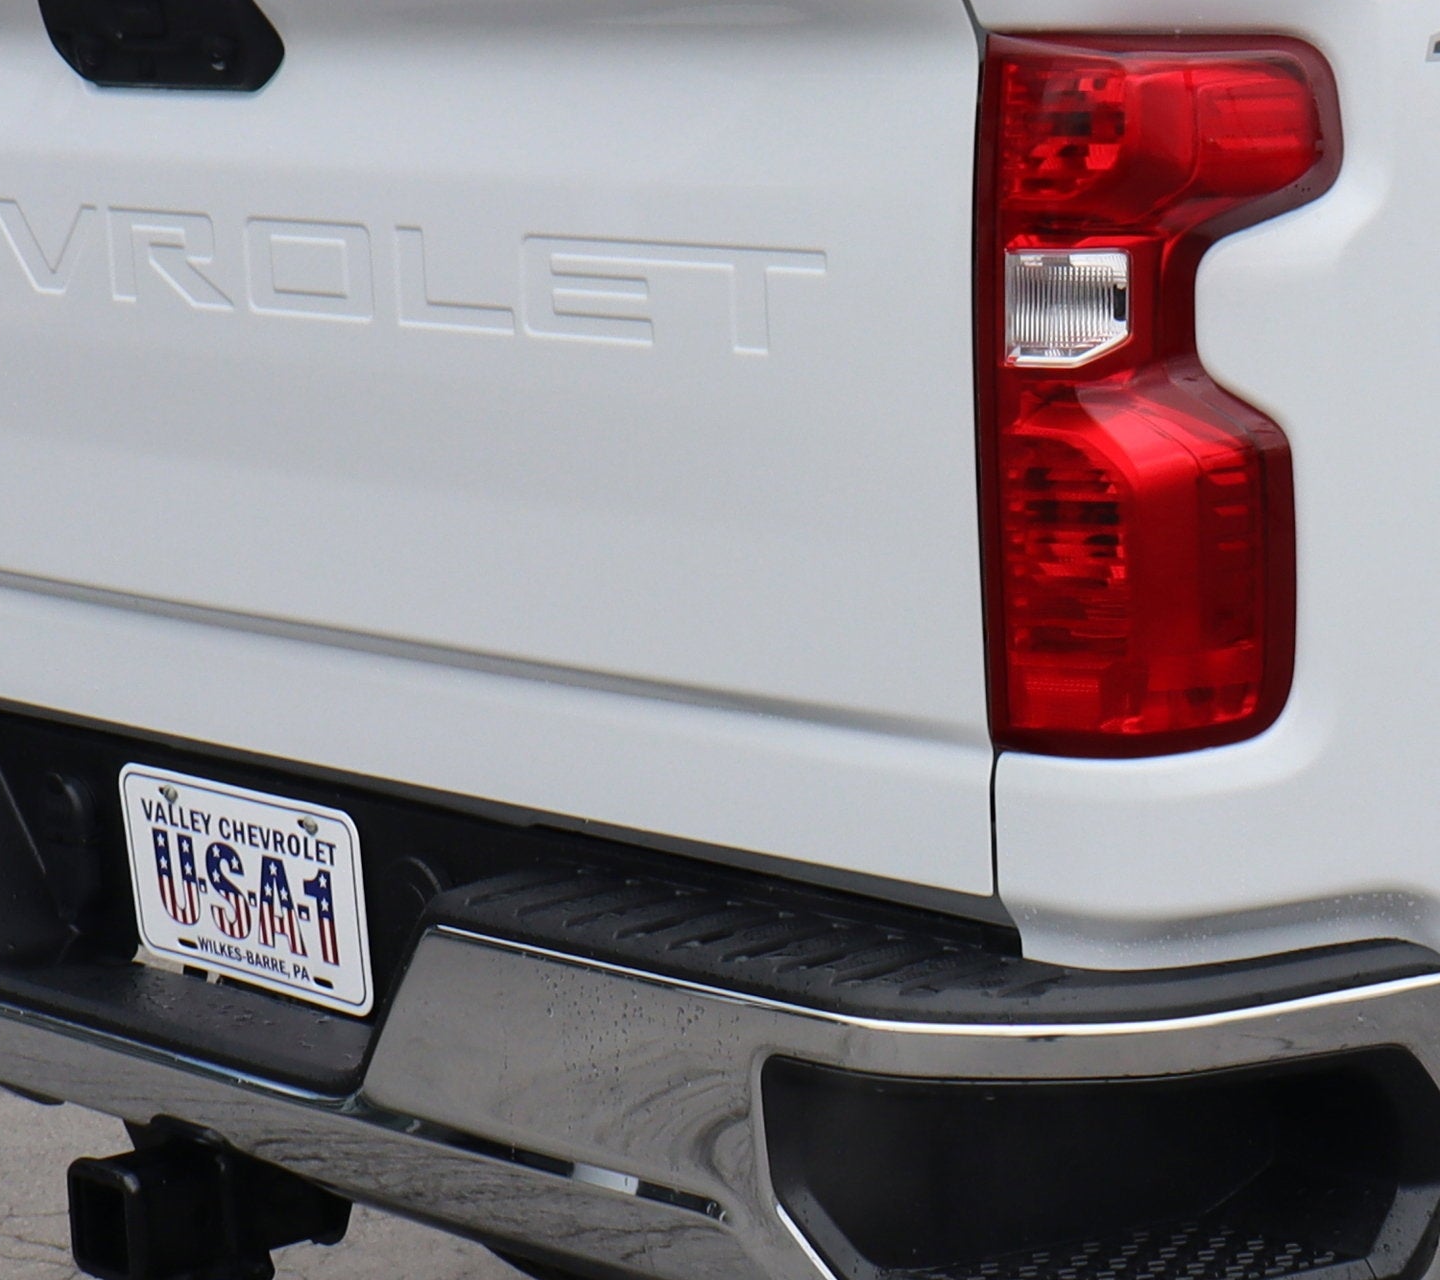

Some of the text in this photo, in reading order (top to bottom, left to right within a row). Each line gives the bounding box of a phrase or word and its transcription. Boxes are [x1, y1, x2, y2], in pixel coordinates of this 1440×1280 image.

[140, 797, 337, 867] VALLEY CHEVROLET
[197, 936, 311, 982] WILKES-BARRE, PA
